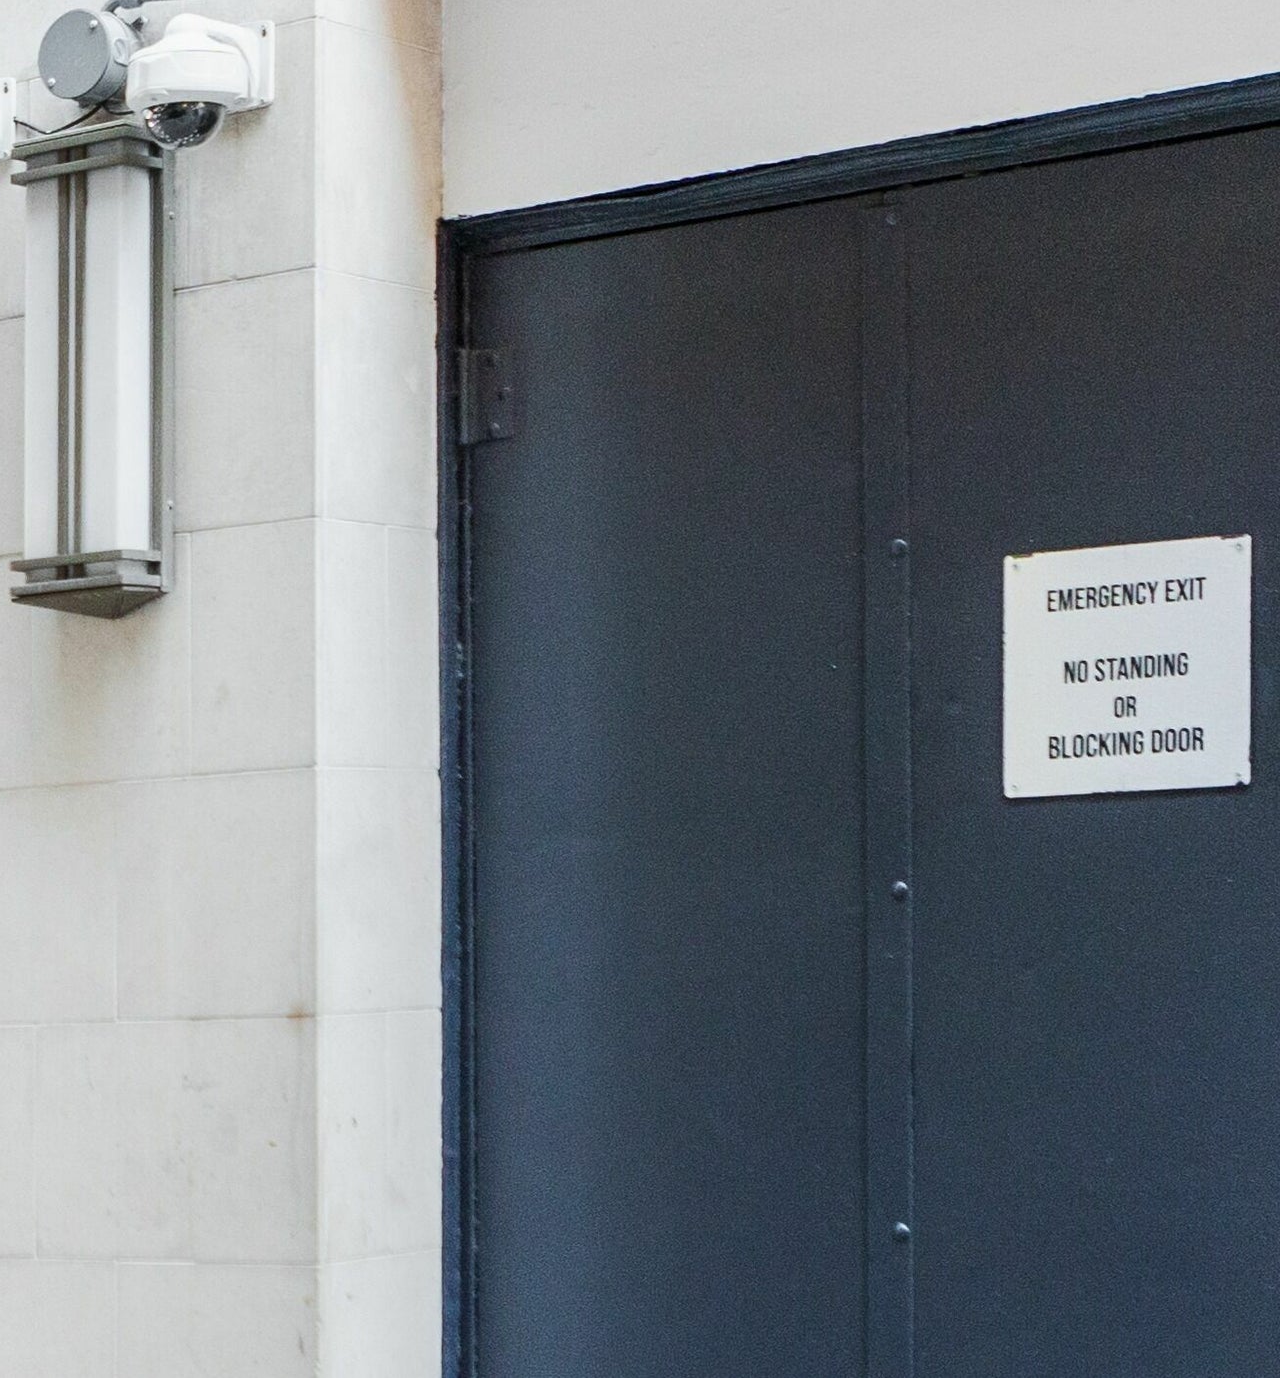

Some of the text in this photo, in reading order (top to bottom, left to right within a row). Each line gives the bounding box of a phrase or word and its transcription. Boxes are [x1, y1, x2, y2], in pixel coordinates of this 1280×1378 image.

[1047, 576, 1207, 612] EMERGENCY EXIT
[1064, 652, 1189, 684] NO STANDING
[1114, 695, 1137, 718] OR
[1048, 727, 1205, 760] BLOCKING DOOR
